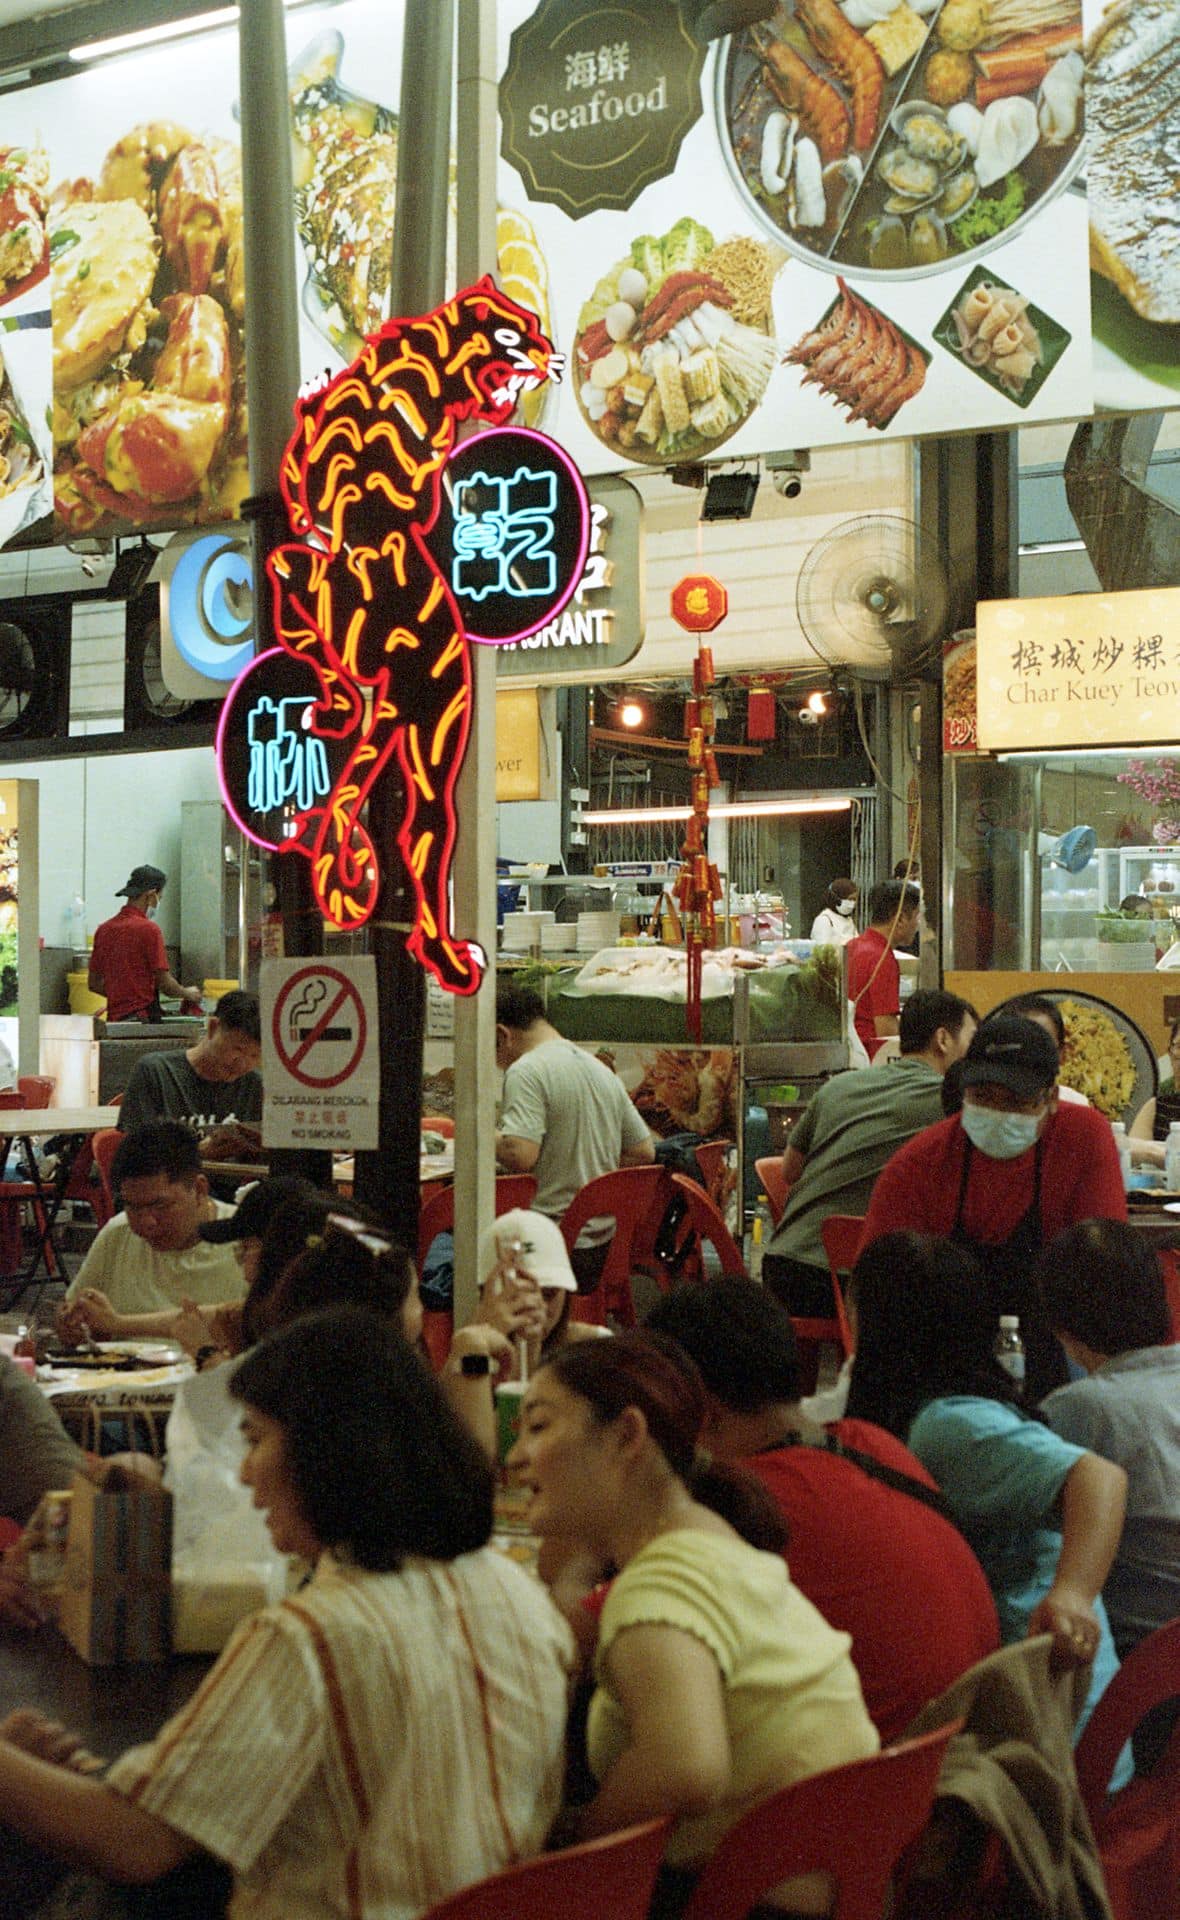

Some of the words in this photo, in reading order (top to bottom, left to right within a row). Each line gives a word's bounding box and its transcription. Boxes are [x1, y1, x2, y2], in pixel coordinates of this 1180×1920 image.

[565, 42, 630, 91] 海鲜
[528, 76, 669, 137] Seafood
[1011, 634, 1180, 677] 槟城炒粿
[1007, 681, 1060, 705] Char
[1067, 680, 1123, 707] Kuey
[291, 1128, 306, 1139] NO
[308, 1128, 351, 1140] SMOKING
